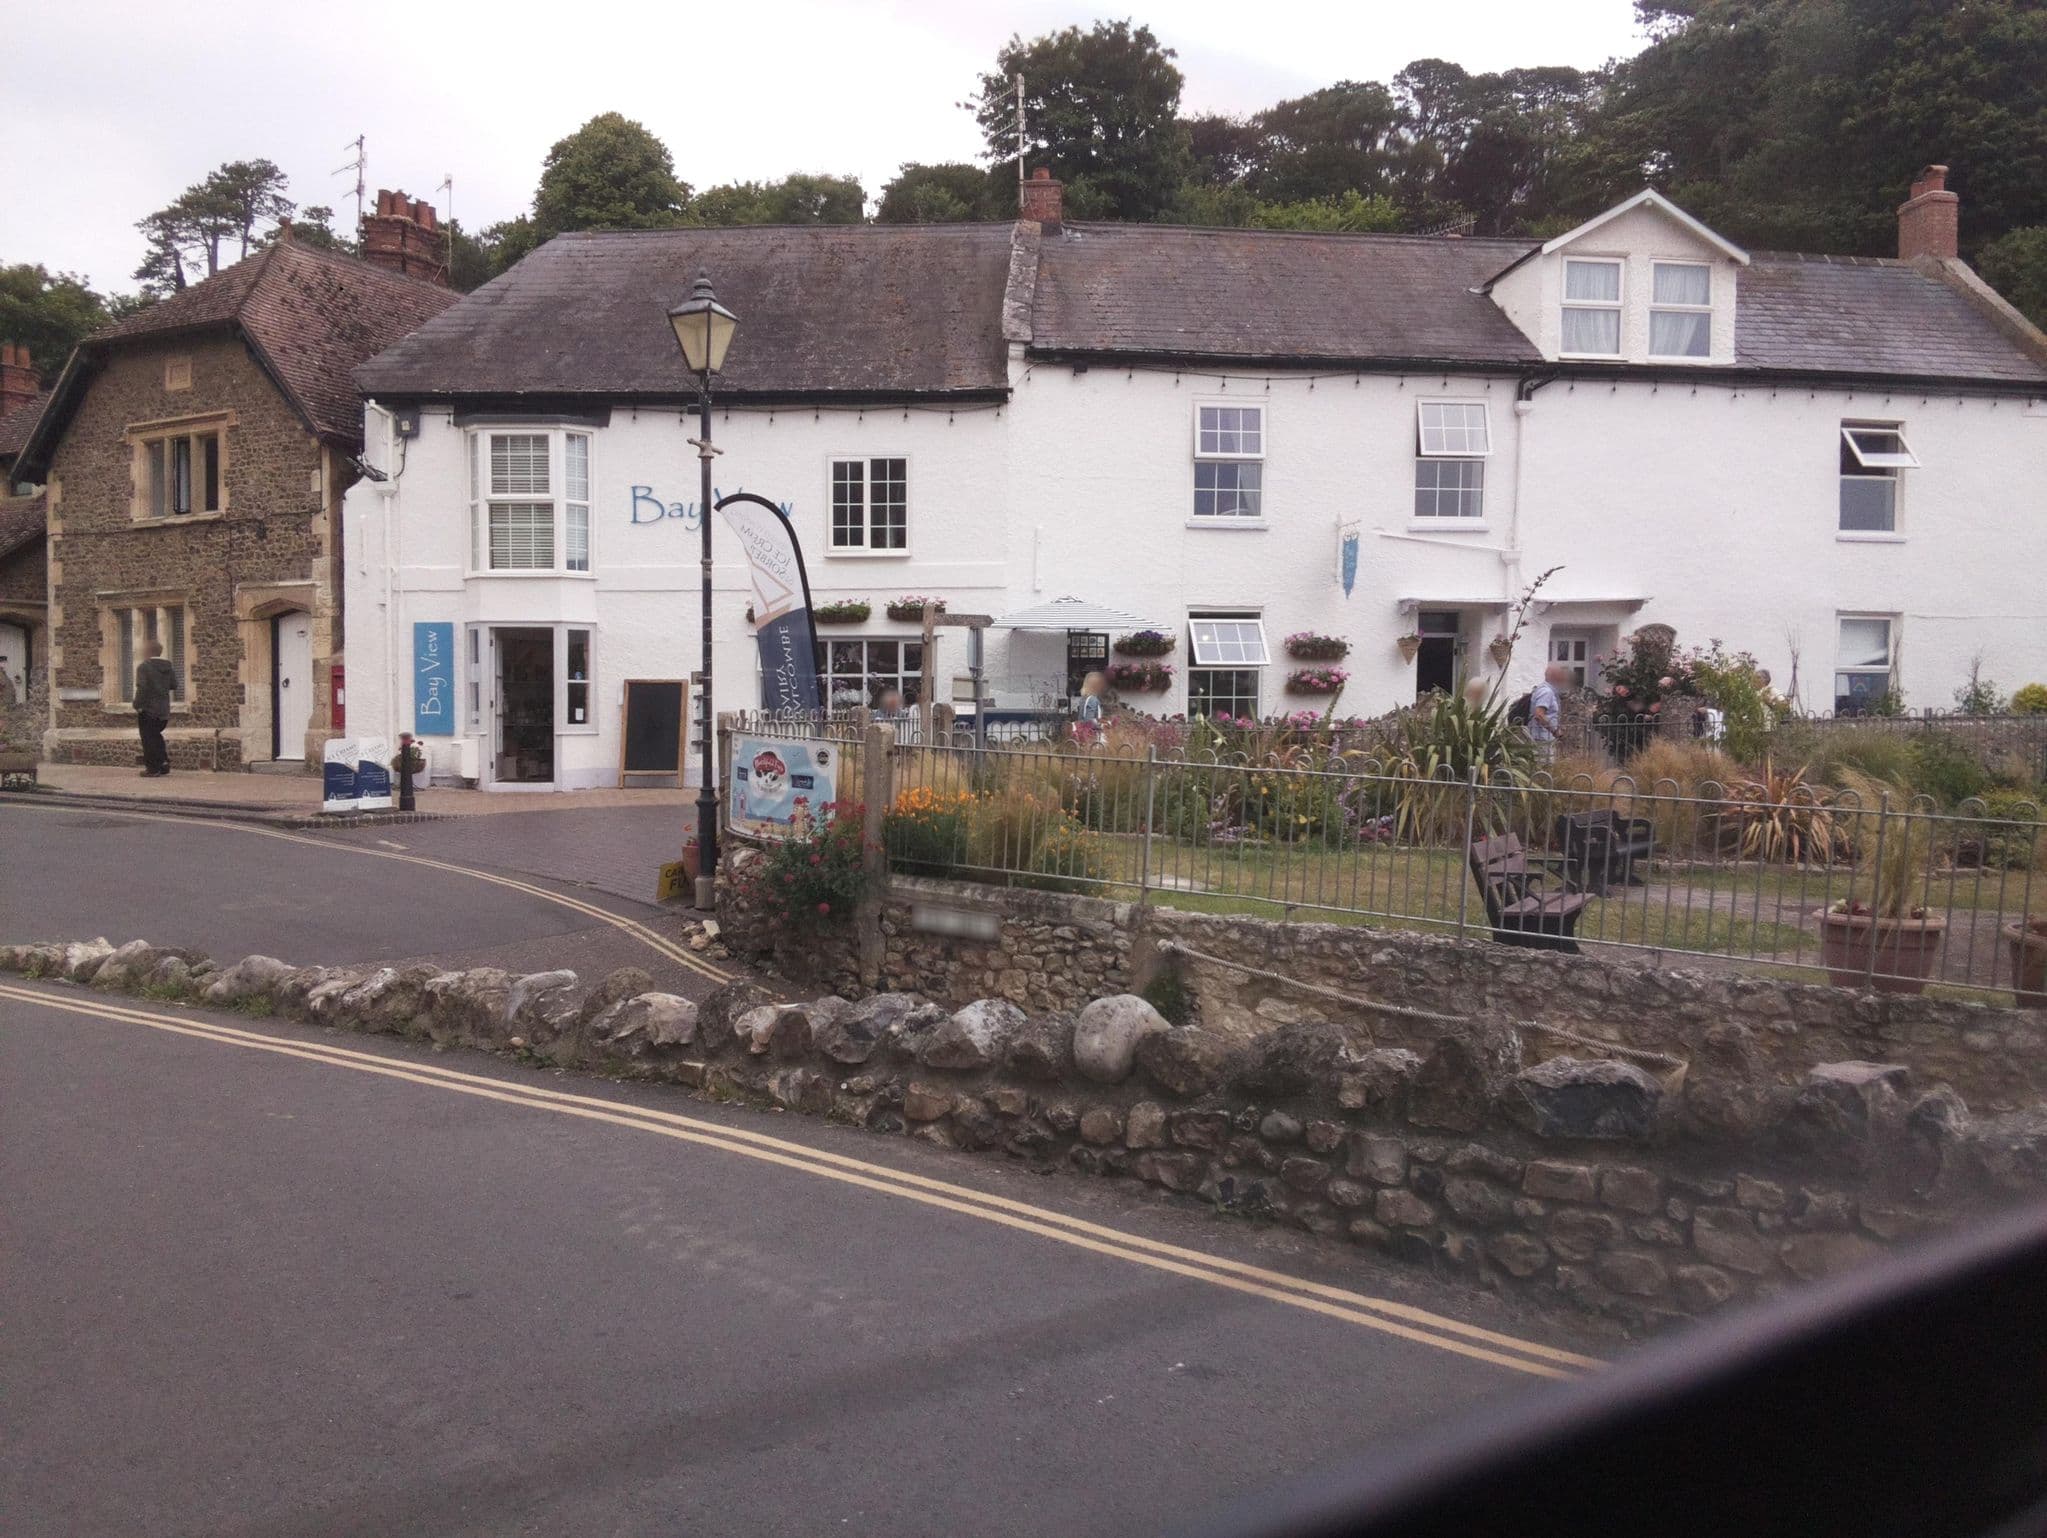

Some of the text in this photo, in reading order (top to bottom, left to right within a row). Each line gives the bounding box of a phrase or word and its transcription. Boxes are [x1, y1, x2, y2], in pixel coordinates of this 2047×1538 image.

[631, 485, 704, 532] Bay
[420, 630, 448, 715] Bay View
